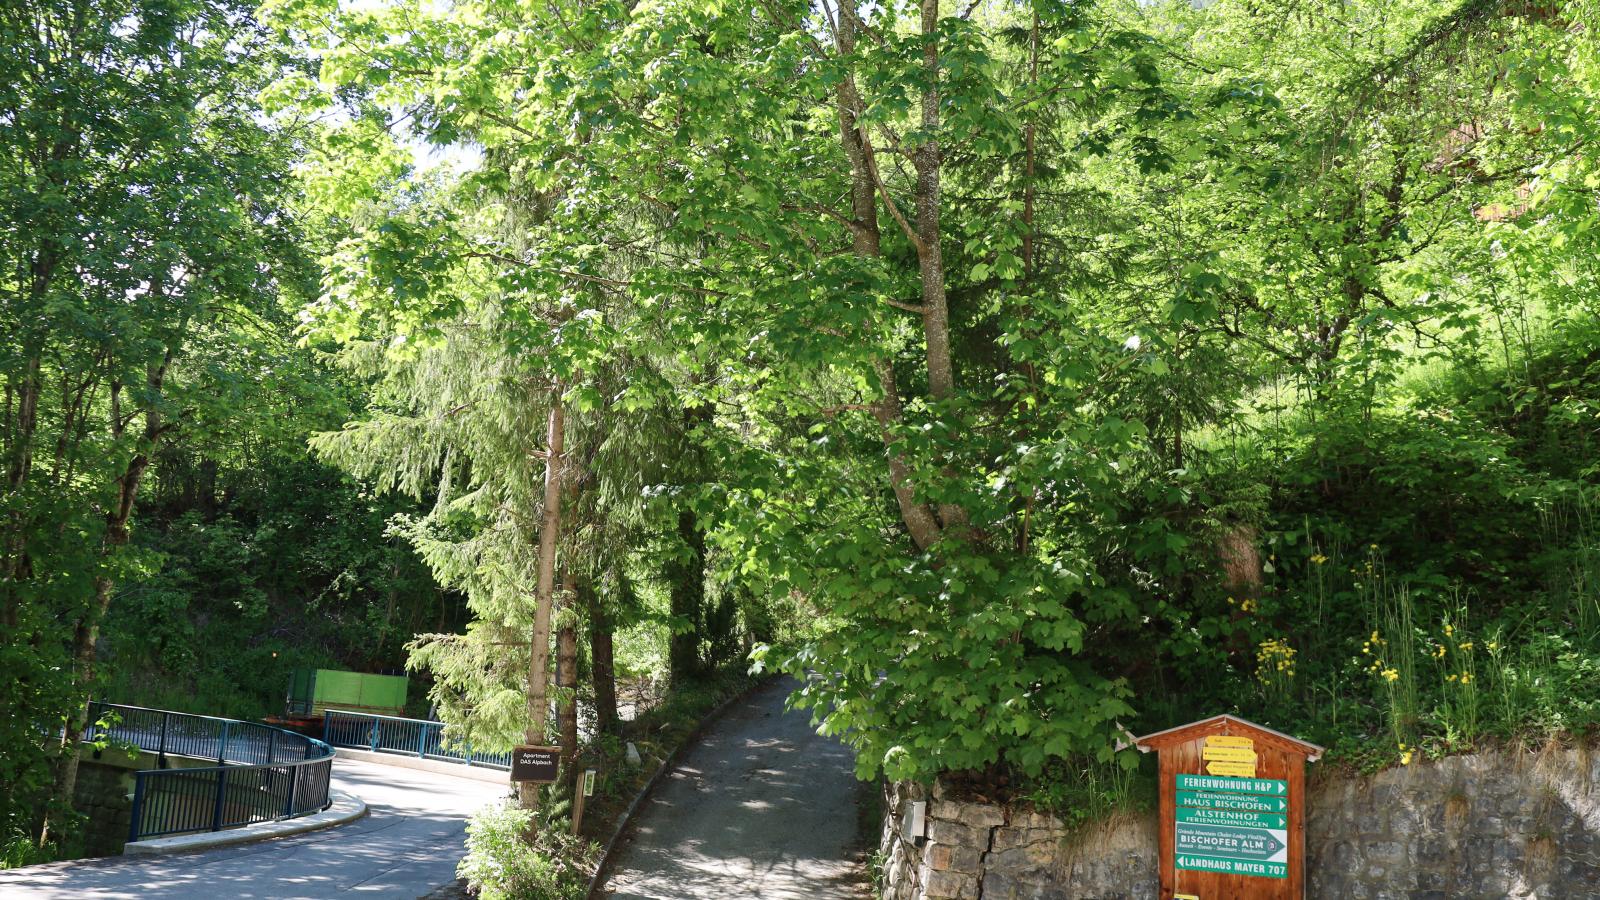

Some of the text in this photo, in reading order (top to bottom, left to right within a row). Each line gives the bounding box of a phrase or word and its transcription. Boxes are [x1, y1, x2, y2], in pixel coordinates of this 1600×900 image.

[1184, 777, 1272, 792] FERIENWOHNUNG H&P
[1195, 793, 1259, 802] FERIENWOHNUNG
[1184, 798, 1272, 810] HAUS BISCHOFEN
[1194, 810, 1259, 820] ALSTENHOF
[1186, 817, 1269, 828] FERIENWOHNUNGEN
[1181, 835, 1264, 849] BISCHOFER ALM
[1185, 858, 1285, 875] LANDHAUS MAYER 707
